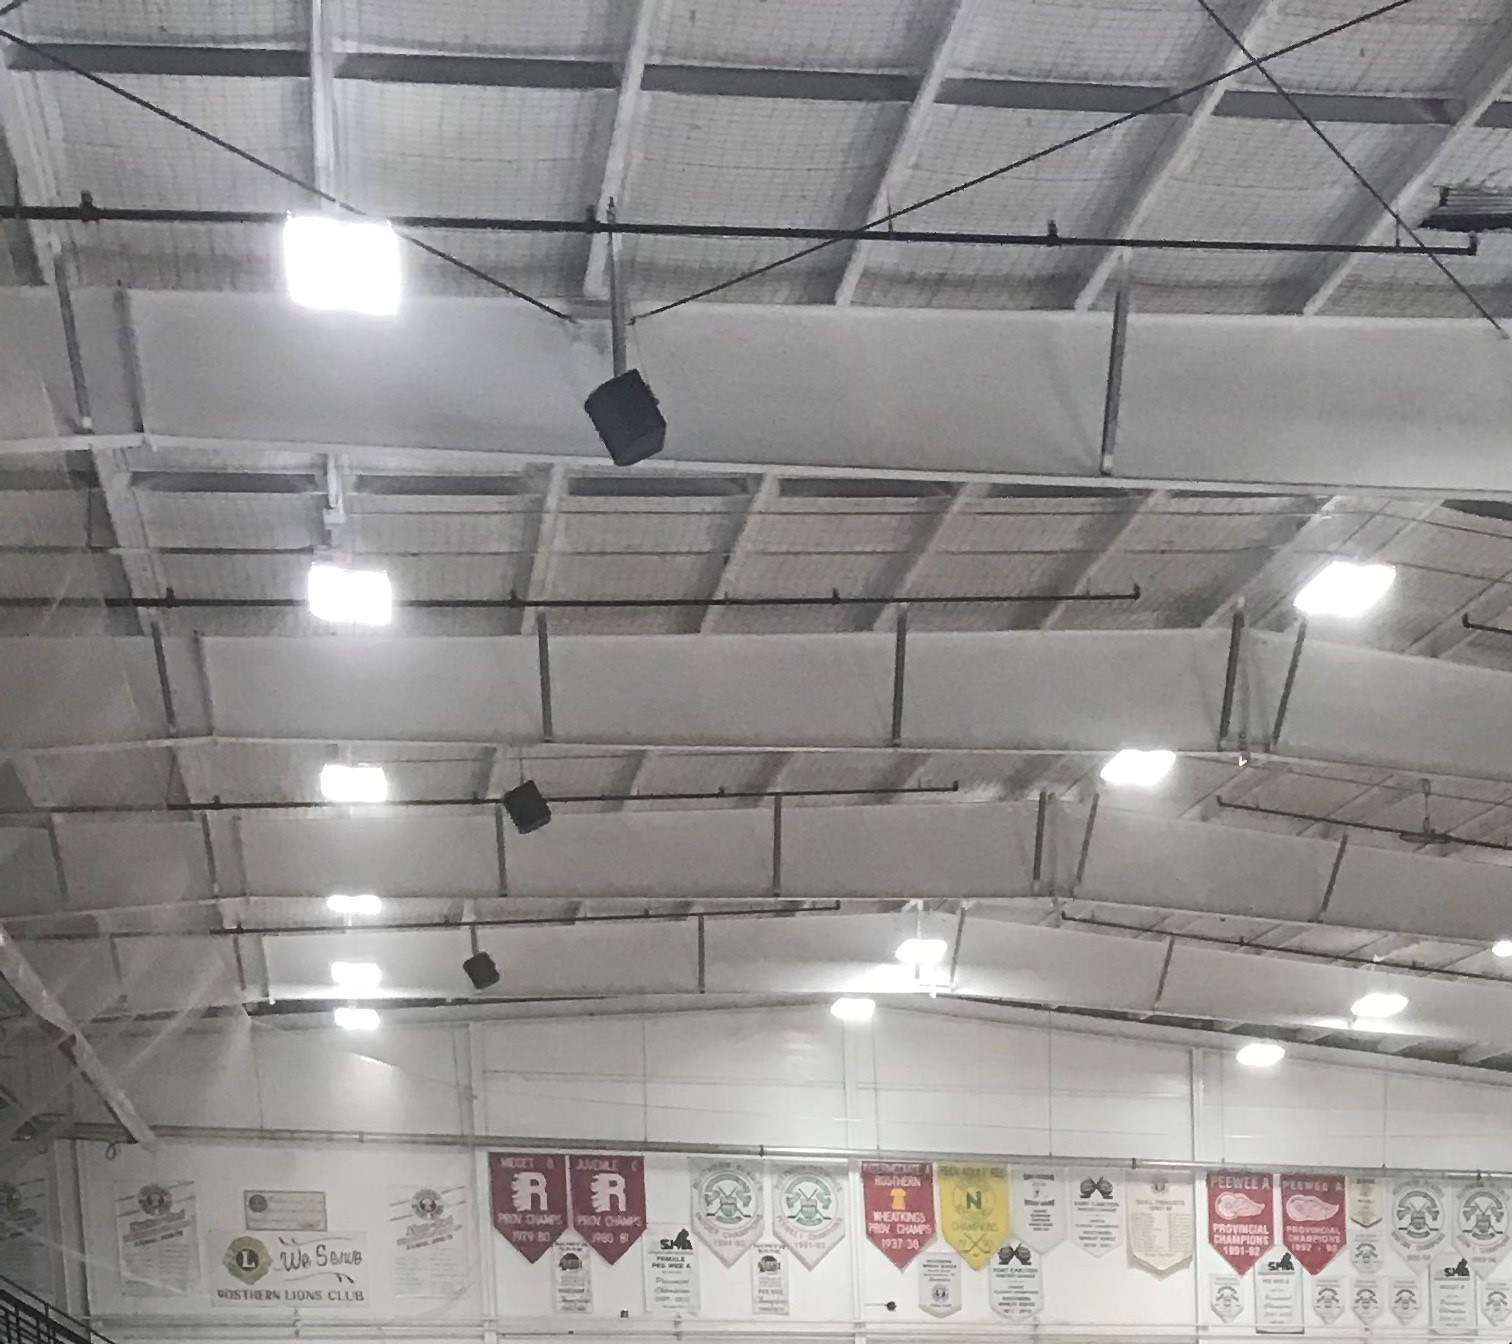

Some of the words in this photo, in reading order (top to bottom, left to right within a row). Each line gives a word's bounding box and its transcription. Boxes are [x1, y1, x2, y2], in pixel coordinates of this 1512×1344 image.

[1211, 1175, 1258, 1190] PEEWEE
[1261, 1176, 1270, 1190] A
[966, 1190, 982, 1210] N
[1213, 1223, 1270, 1235] PROVINCIAL
[1286, 1225, 1341, 1235] PROVINCIAL
[1213, 1235, 1270, 1246] CHAMPIONS
[1287, 1234, 1341, 1243] CHAMPIONS
[280, 1249, 312, 1272] We
[316, 1244, 363, 1267] Serve
[217, 1288, 281, 1301] ROSTHERN
[285, 1289, 323, 1301] LIONS
[327, 1289, 365, 1302] CLUB
